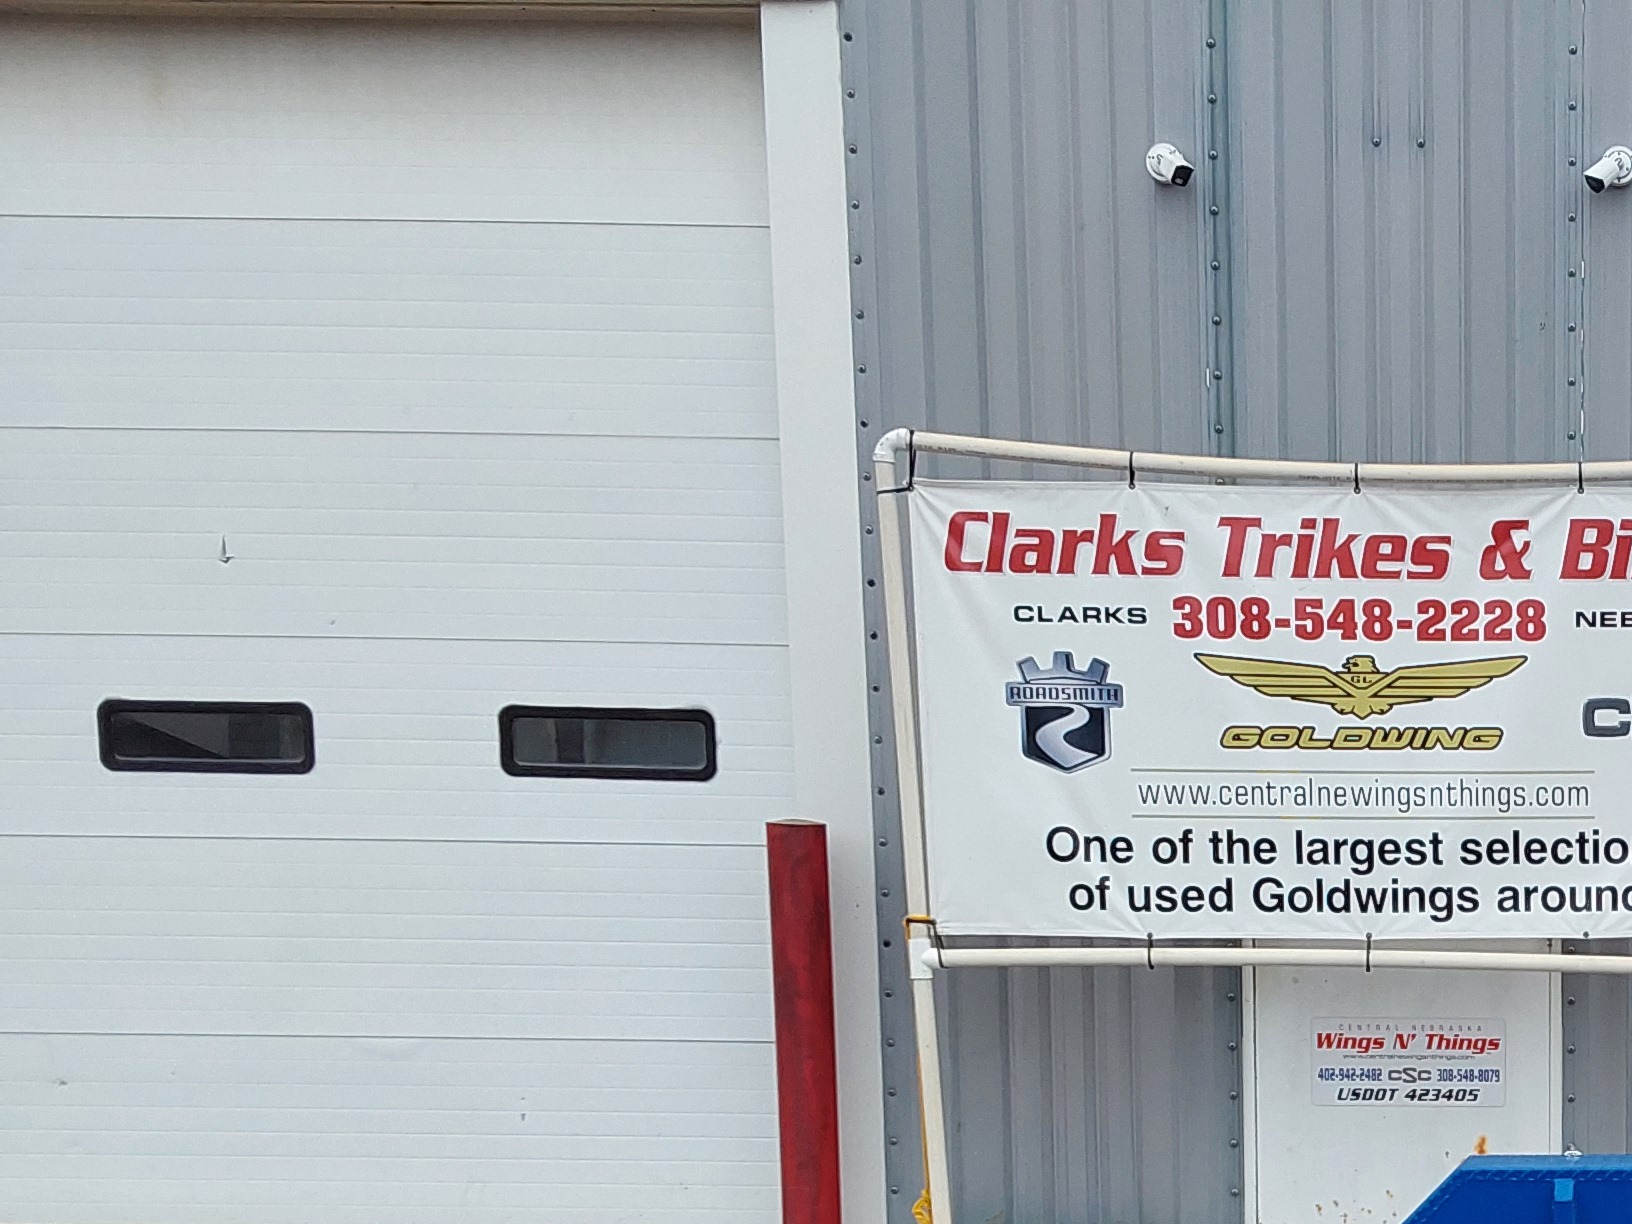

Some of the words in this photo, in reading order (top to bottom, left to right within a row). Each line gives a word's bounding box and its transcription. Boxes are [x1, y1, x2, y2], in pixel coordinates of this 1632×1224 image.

[944, 511, 1187, 577] Clarks
[1217, 516, 1454, 581] Trikes
[1479, 519, 1534, 582] &
[1013, 605, 1149, 627] CLARKS
[1172, 596, 1548, 643] 308-548-2228
[1350, 676, 1373, 684] GL
[1009, 686, 1119, 702] ROADSMITH
[1220, 726, 1504, 750] GOLDWING
[1138, 779, 1591, 814] www.centralnewingsnthings.com
[1045, 827, 1135, 867] One
[1152, 828, 1196, 866] of
[1208, 829, 1279, 867] the
[1295, 829, 1446, 877] largest
[1069, 876, 1112, 913] of
[1128, 878, 1235, 915] used
[1252, 877, 1482, 923] Goldwings
[1339, 1023, 1399, 1031] CENTRAL
[1411, 1024, 1483, 1032] NEBRASKA
[1316, 1032, 1386, 1053] Wings
[1393, 1033, 1417, 1050] N'
[1425, 1033, 1501, 1054] Things
[1317, 1067, 1383, 1082] 402-942-2482
[1436, 1068, 1501, 1083] 308-548-8079
[1337, 1088, 1399, 1101] USDOT
[1404, 1088, 1480, 1102] 423405
